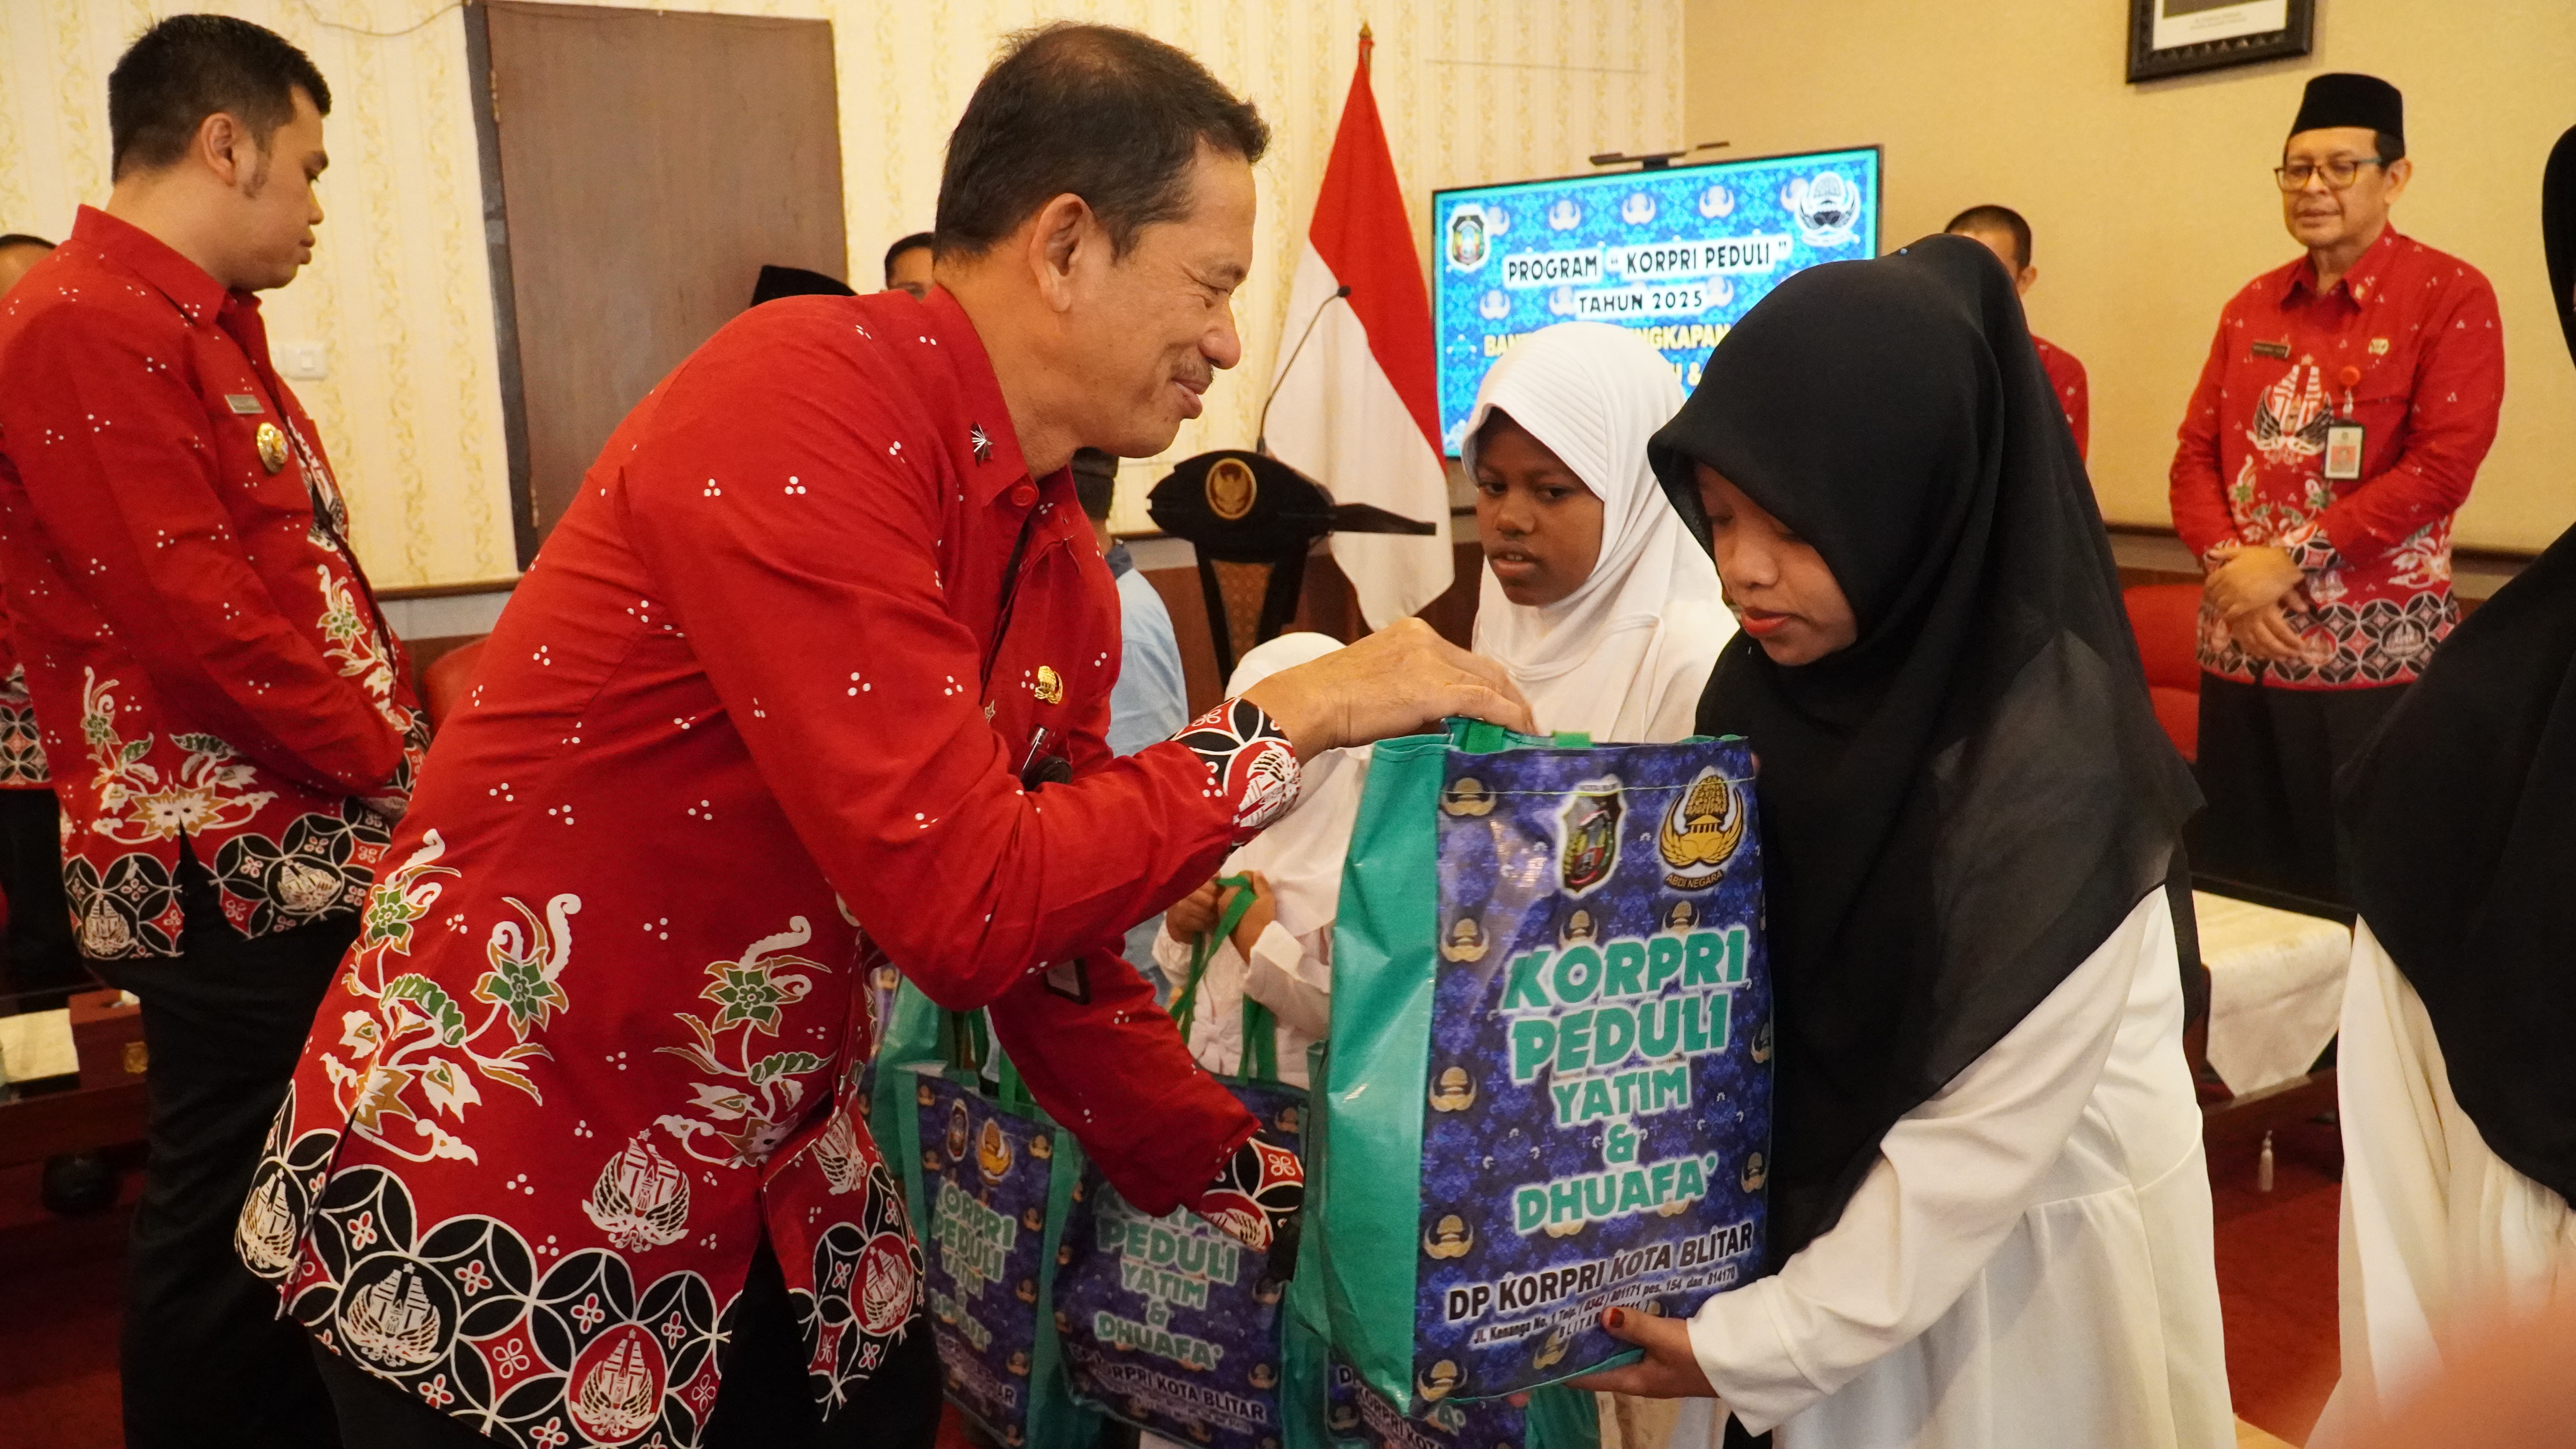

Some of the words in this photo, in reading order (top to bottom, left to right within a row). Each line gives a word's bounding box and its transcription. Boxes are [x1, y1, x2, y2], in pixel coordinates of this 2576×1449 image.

[1509, 255, 1597, 282] PROGRAM
[1627, 248, 1696, 274] KORPRI
[1705, 243, 1769, 268] PEDULI
[1580, 294, 1642, 313] TAHUN
[1653, 290, 1702, 309] 2025
[1666, 874, 1687, 888] ABDI
[1687, 870, 1722, 888] NEGARA
[1504, 929, 1746, 1009] KORPRI
[1511, 993, 1729, 1080] PEDULI
[1552, 1066, 1688, 1124] YATIM
[1606, 1123, 1637, 1164] &
[1099, 1218, 1239, 1283] PEDULI
[1449, 1286, 1490, 1321] DP
[1499, 1261, 1605, 1311] KORPRI
[1609, 1245, 1670, 1283] KOTA
[1679, 1222, 1753, 1267] BLITAR
[1121, 1263, 1206, 1308] YATIM
[1666, 1278, 1683, 1291] 154
[1686, 1276, 1703, 1288] dan
[1148, 1301, 1171, 1326] &
[1157, 1376, 1199, 1402] KOTA
[1203, 1390, 1264, 1420] BLITAR
